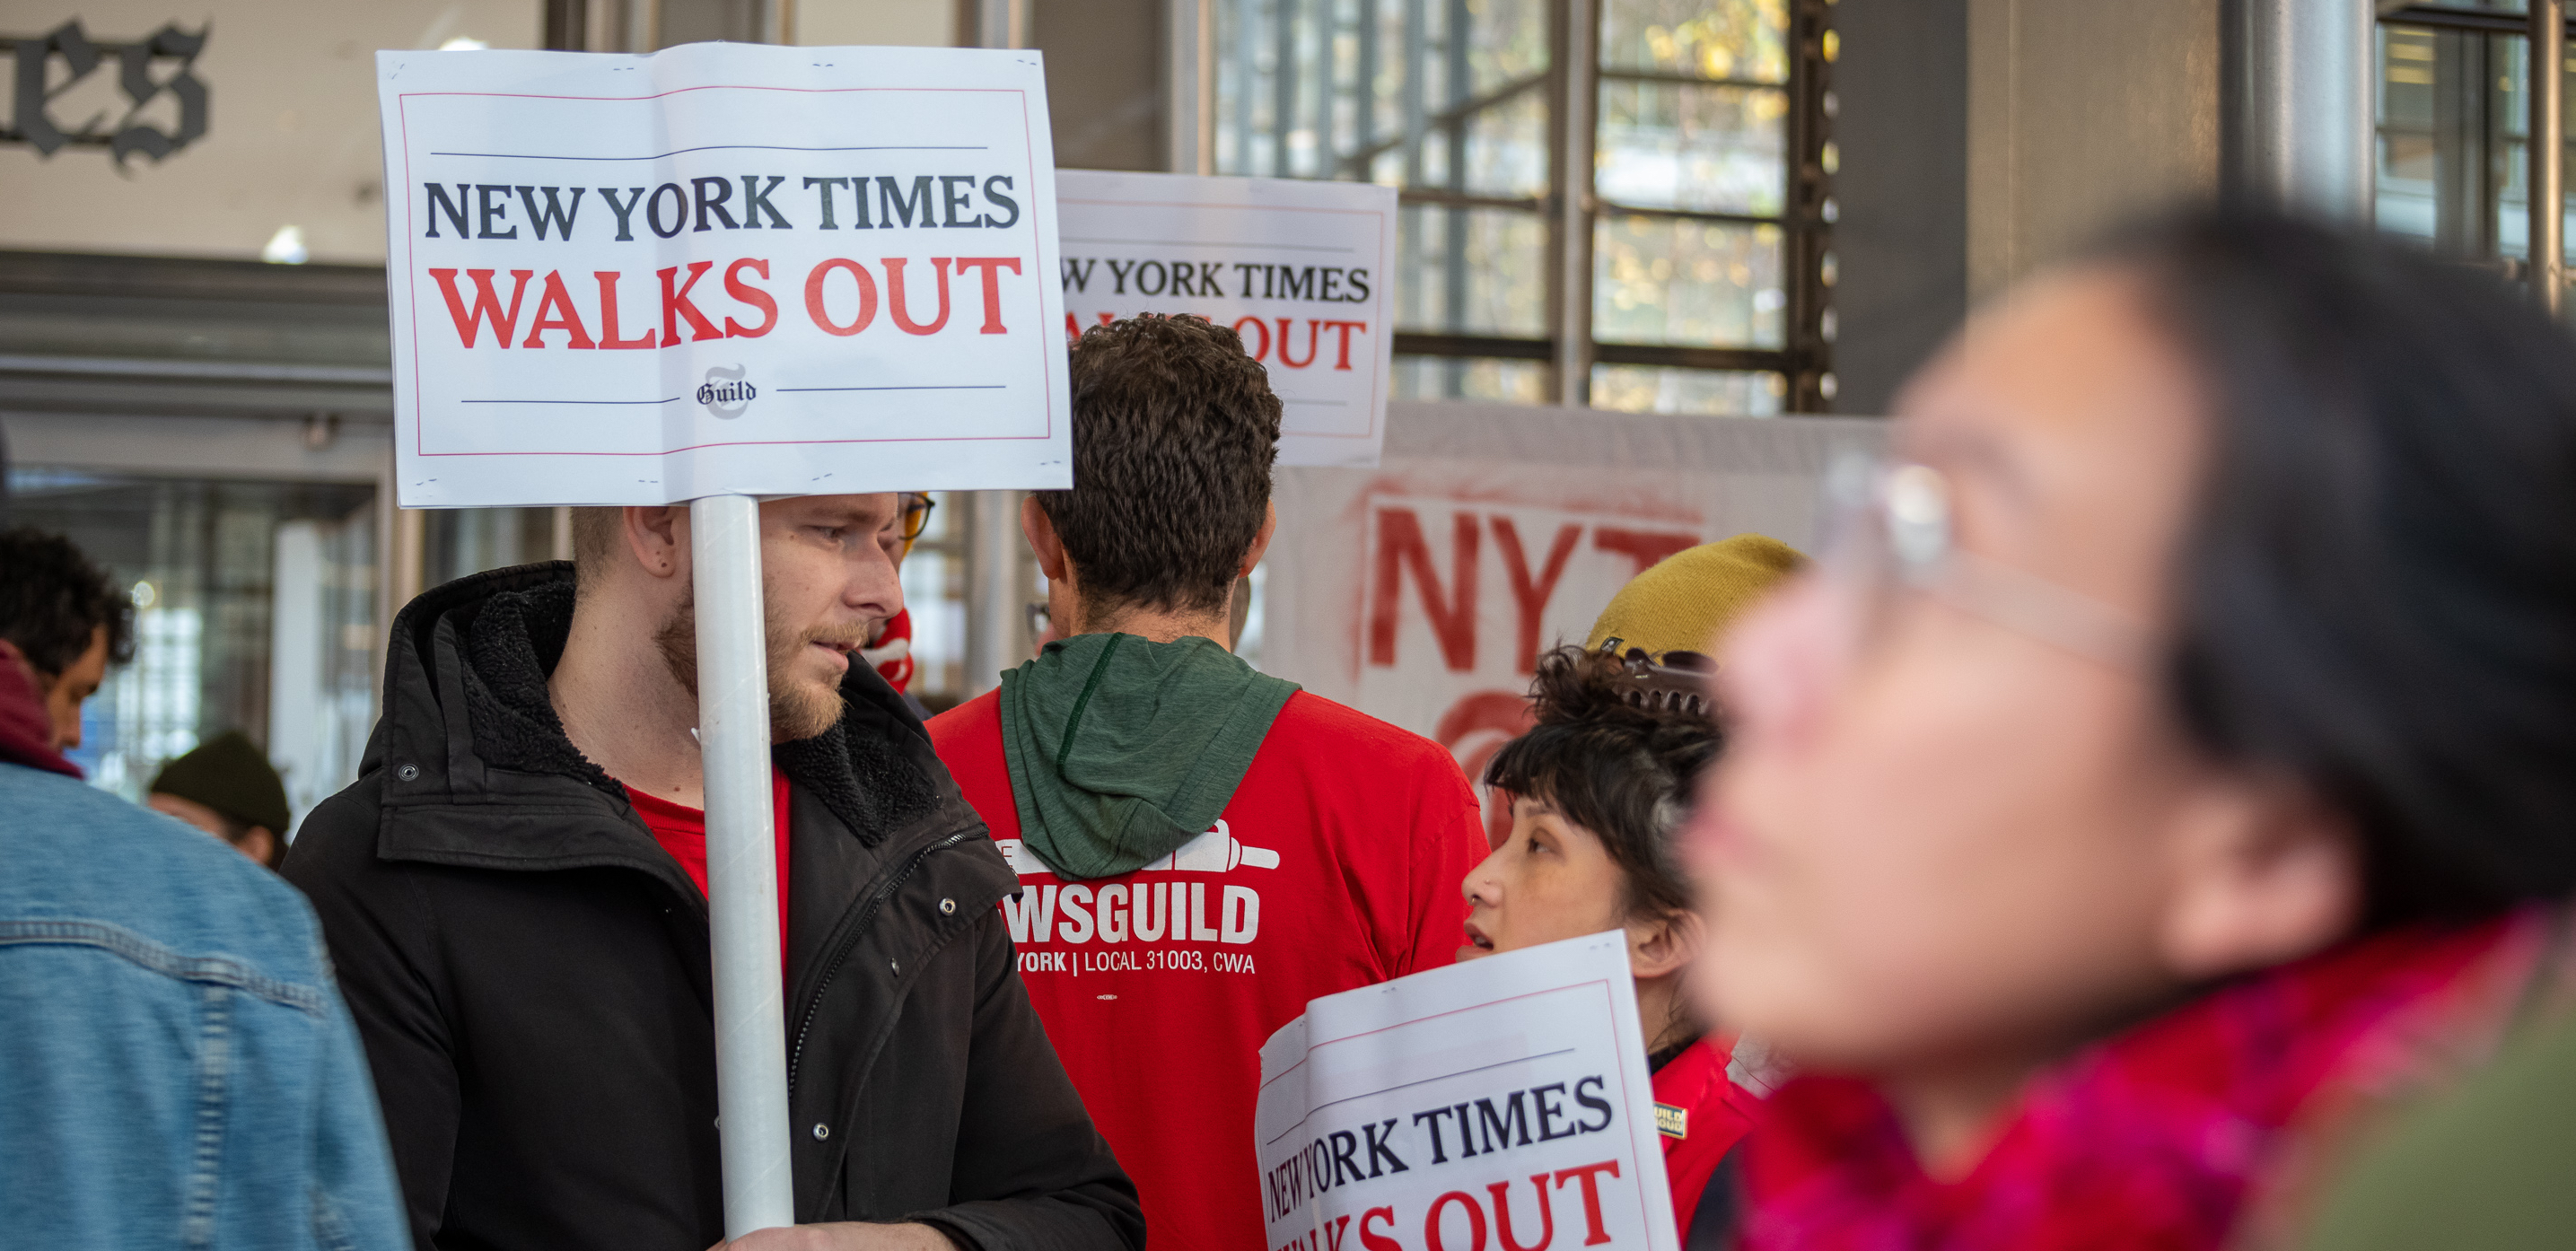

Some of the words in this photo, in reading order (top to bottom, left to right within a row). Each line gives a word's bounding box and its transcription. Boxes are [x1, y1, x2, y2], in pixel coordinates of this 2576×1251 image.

[0, 15, 214, 179] es
[424, 183, 585, 241] NEW
[598, 176, 793, 241] YORK
[803, 175, 1020, 230] TIMES
[428, 258, 778, 350] WALKS
[804, 258, 1021, 337] OUT
[1060, 258, 1096, 294] W
[1106, 260, 1224, 298] YORK
[1233, 263, 1371, 303] TIMES
[1231, 315, 1367, 372] OUT
[697, 381, 757, 405] Guild
[998, 882, 1260, 944] WSGUILD
[1084, 951, 1142, 972] LOCAL
[1146, 950, 1207, 974] 31003,
[1214, 953, 1256, 975] CWA
[1653, 1107, 1682, 1122] UILD
[1656, 1118, 1682, 1133] OUD
[1267, 1151, 1303, 1223] NEW
[1303, 1117, 1409, 1200] YORK
[1413, 1074, 1613, 1166] TIMES
[1424, 1159, 1621, 1251] OUT
